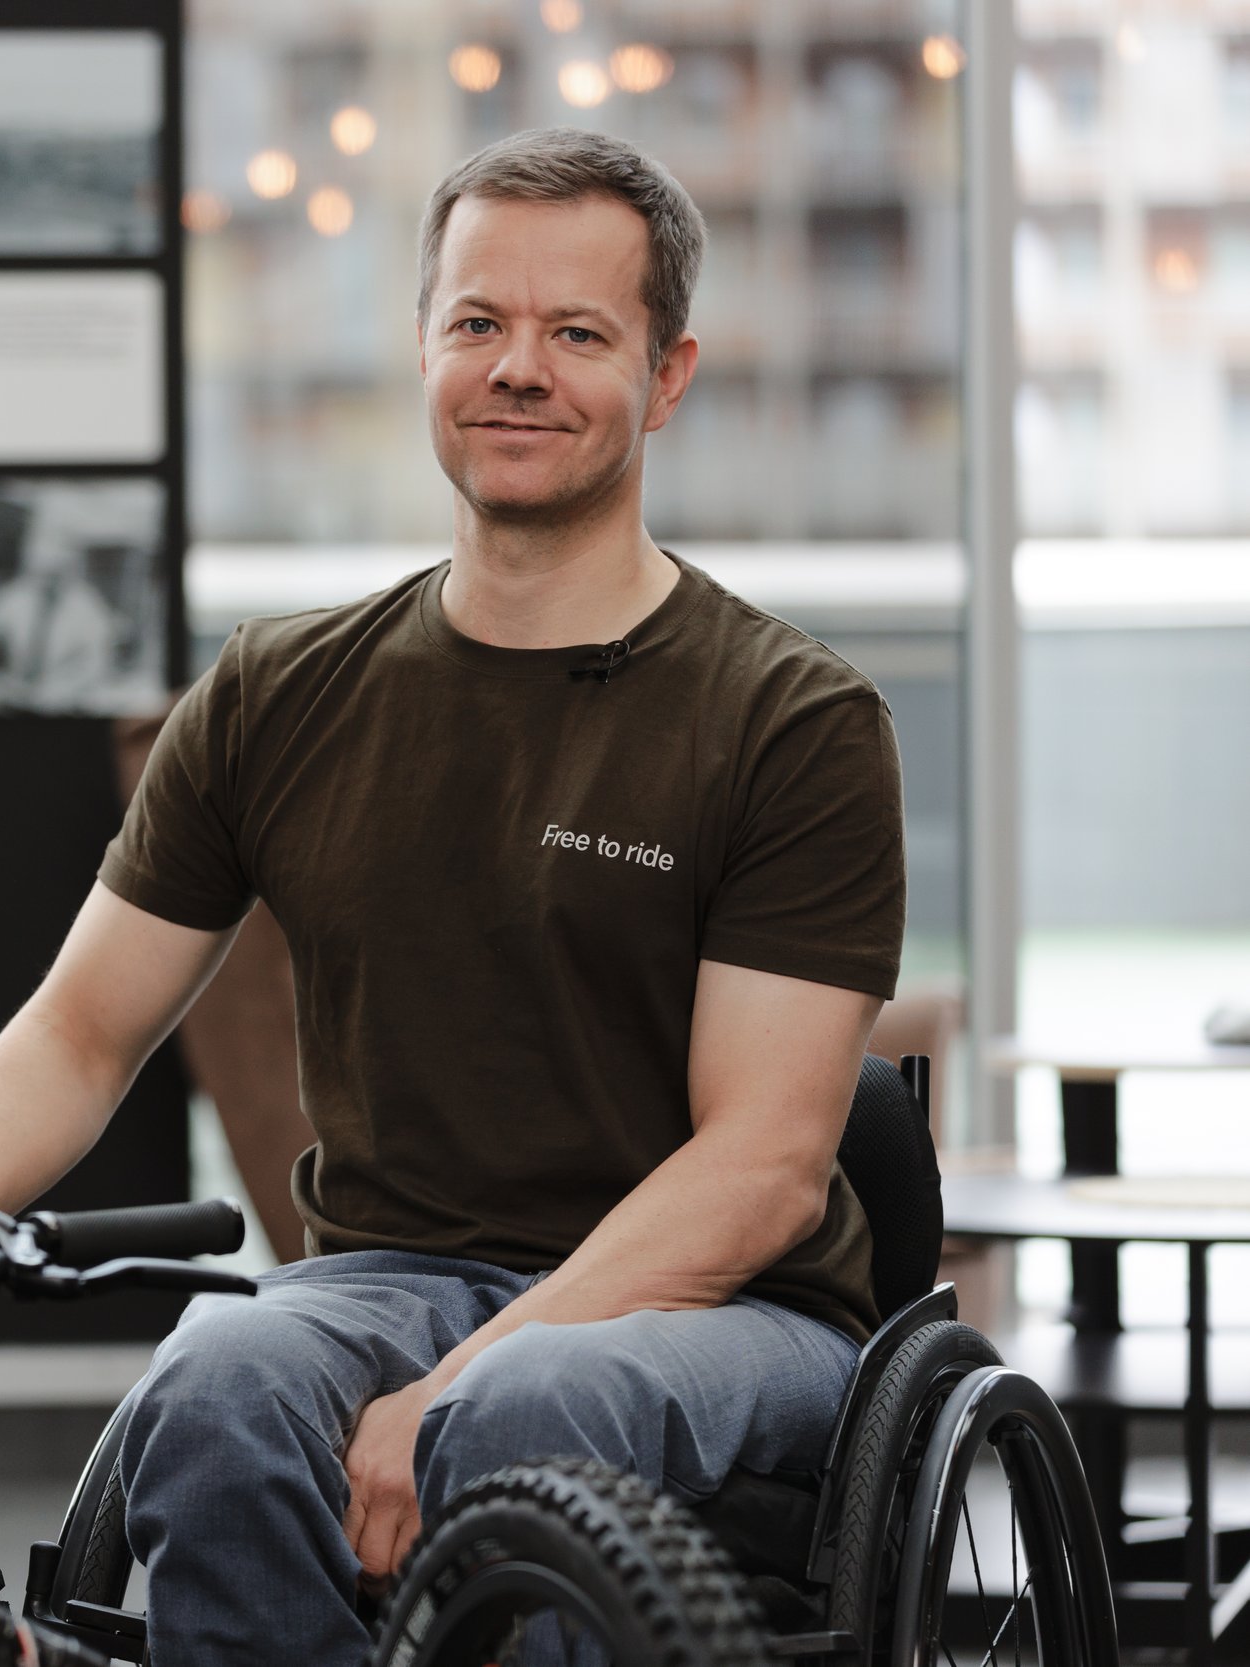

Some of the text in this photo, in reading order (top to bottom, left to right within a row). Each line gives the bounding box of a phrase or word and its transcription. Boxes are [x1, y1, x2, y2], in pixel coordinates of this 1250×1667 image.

[541, 824, 675, 871] Free to ride
